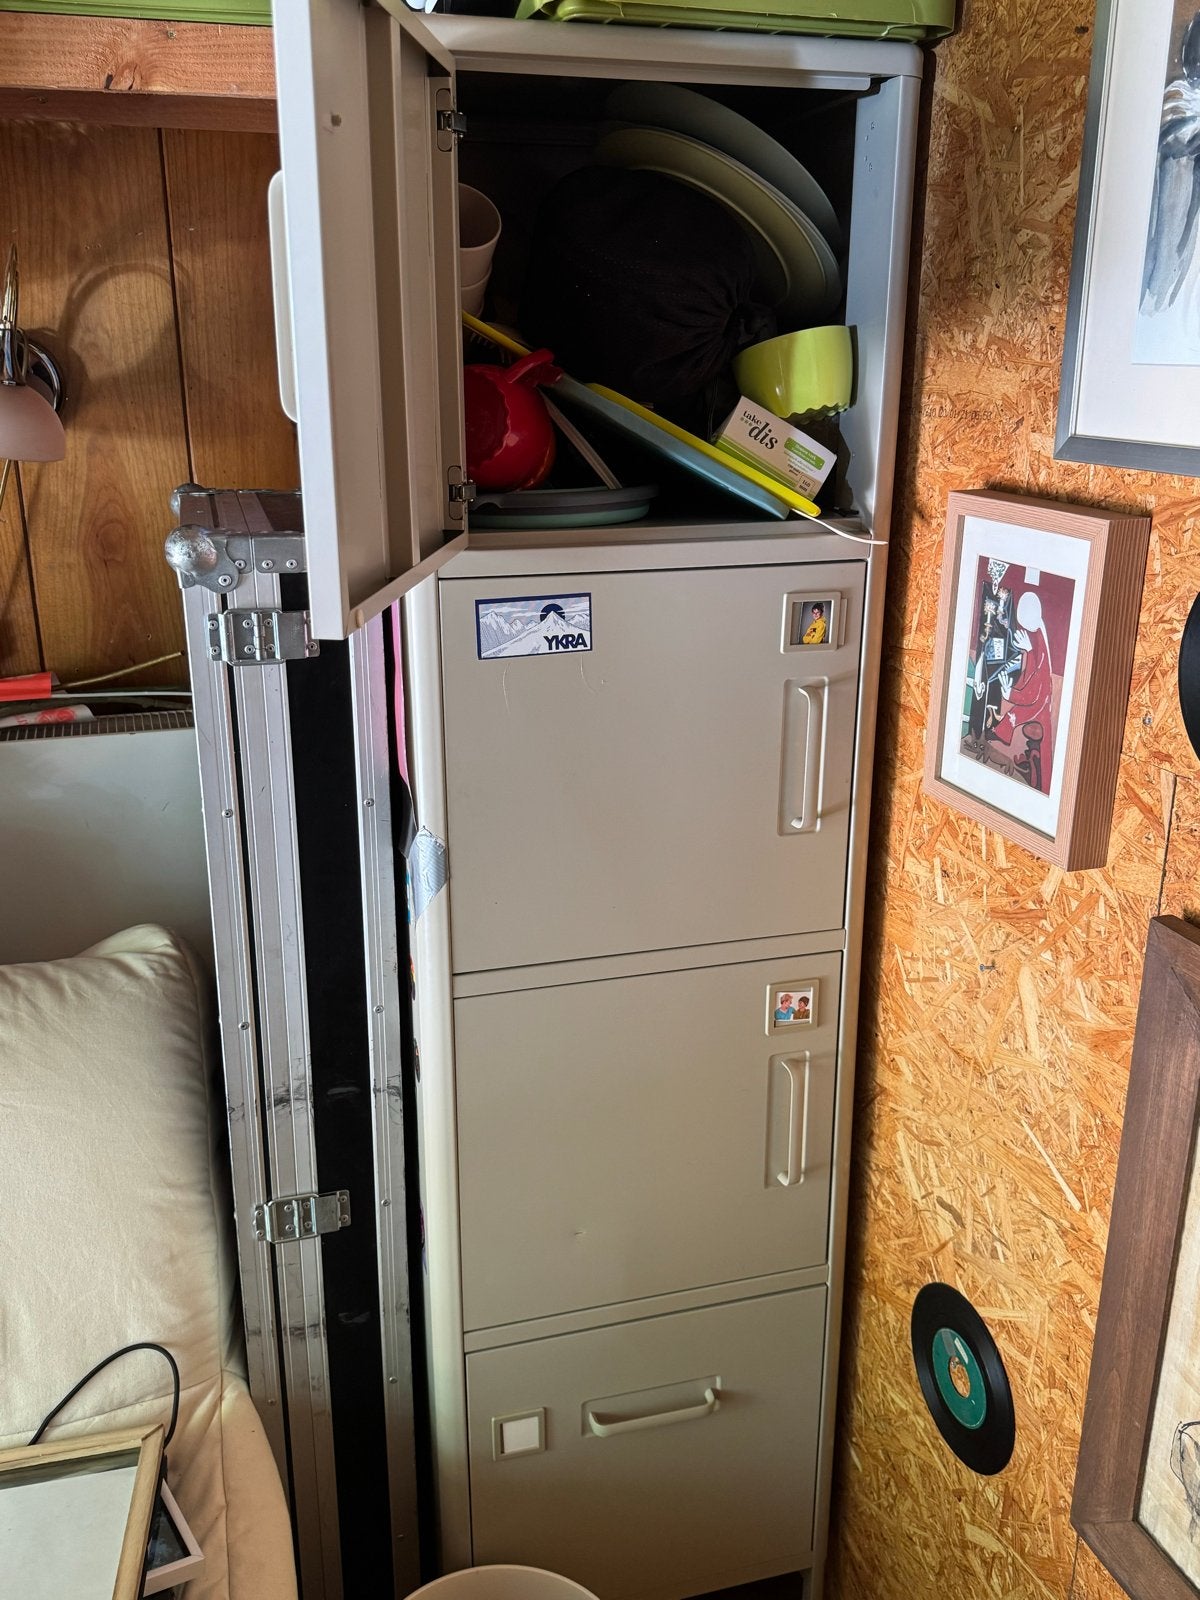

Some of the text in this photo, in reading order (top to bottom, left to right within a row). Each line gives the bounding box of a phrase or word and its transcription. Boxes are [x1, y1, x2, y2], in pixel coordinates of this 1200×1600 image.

[744, 411, 762, 425] take
[749, 422, 778, 449] dis
[543, 633, 588, 650] YKRA
